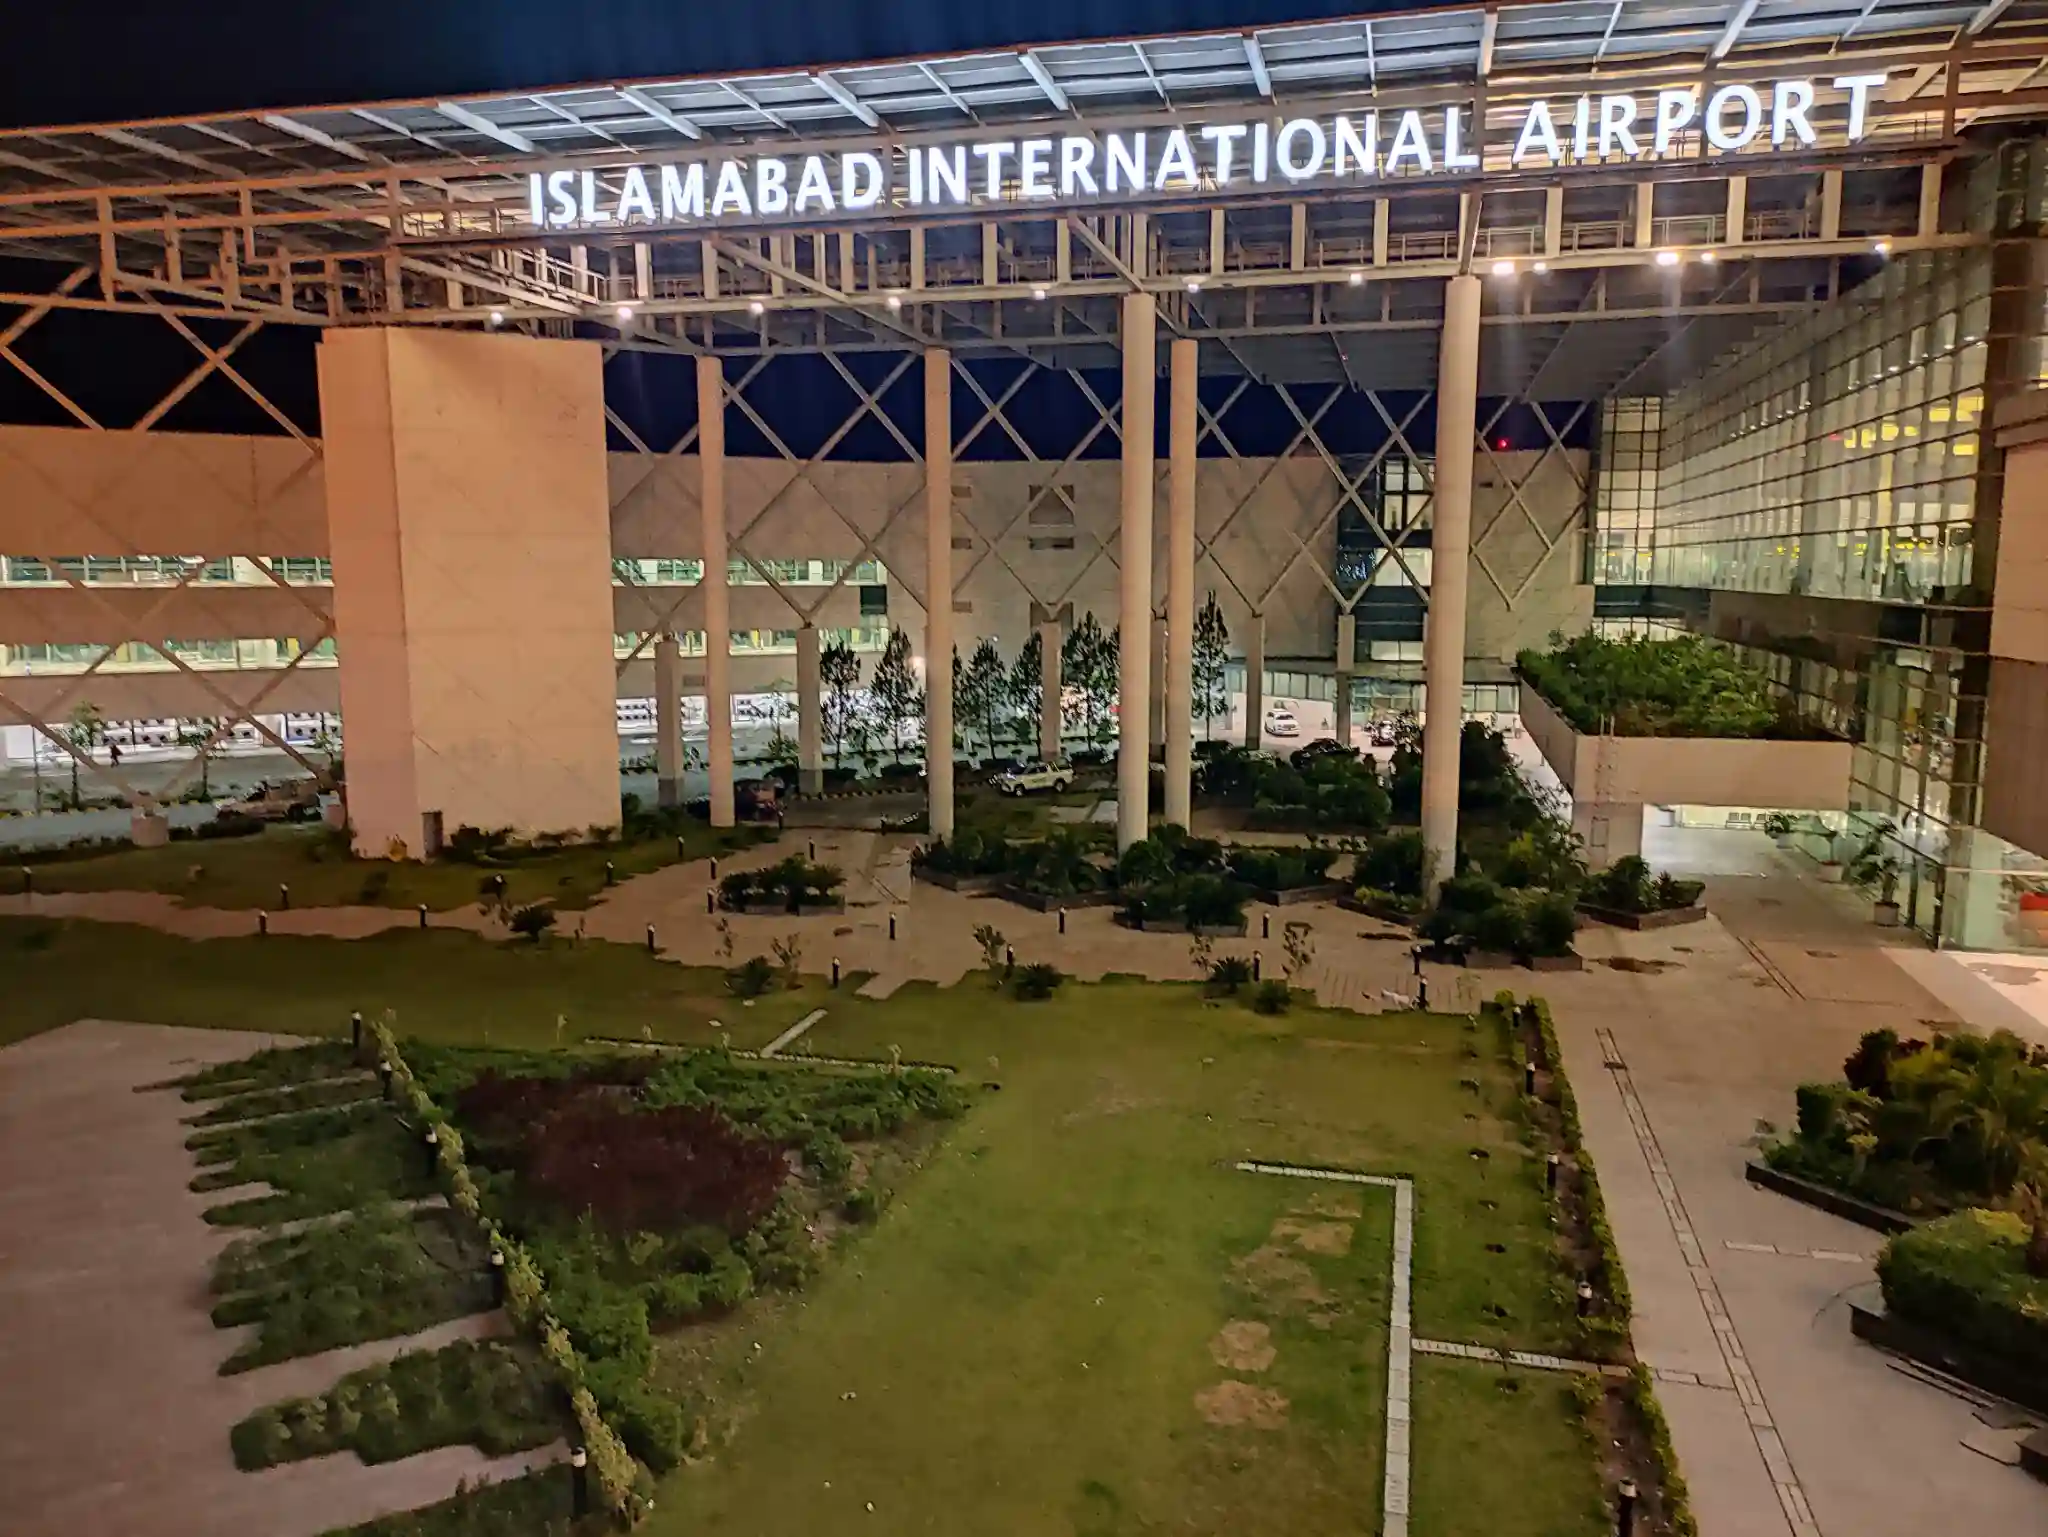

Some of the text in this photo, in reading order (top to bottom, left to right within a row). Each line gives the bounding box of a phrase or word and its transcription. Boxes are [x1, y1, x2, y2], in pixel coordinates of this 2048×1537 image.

[529, 74, 1887, 226] ISLAMABAD INTERNATIONAL AIRPORT
